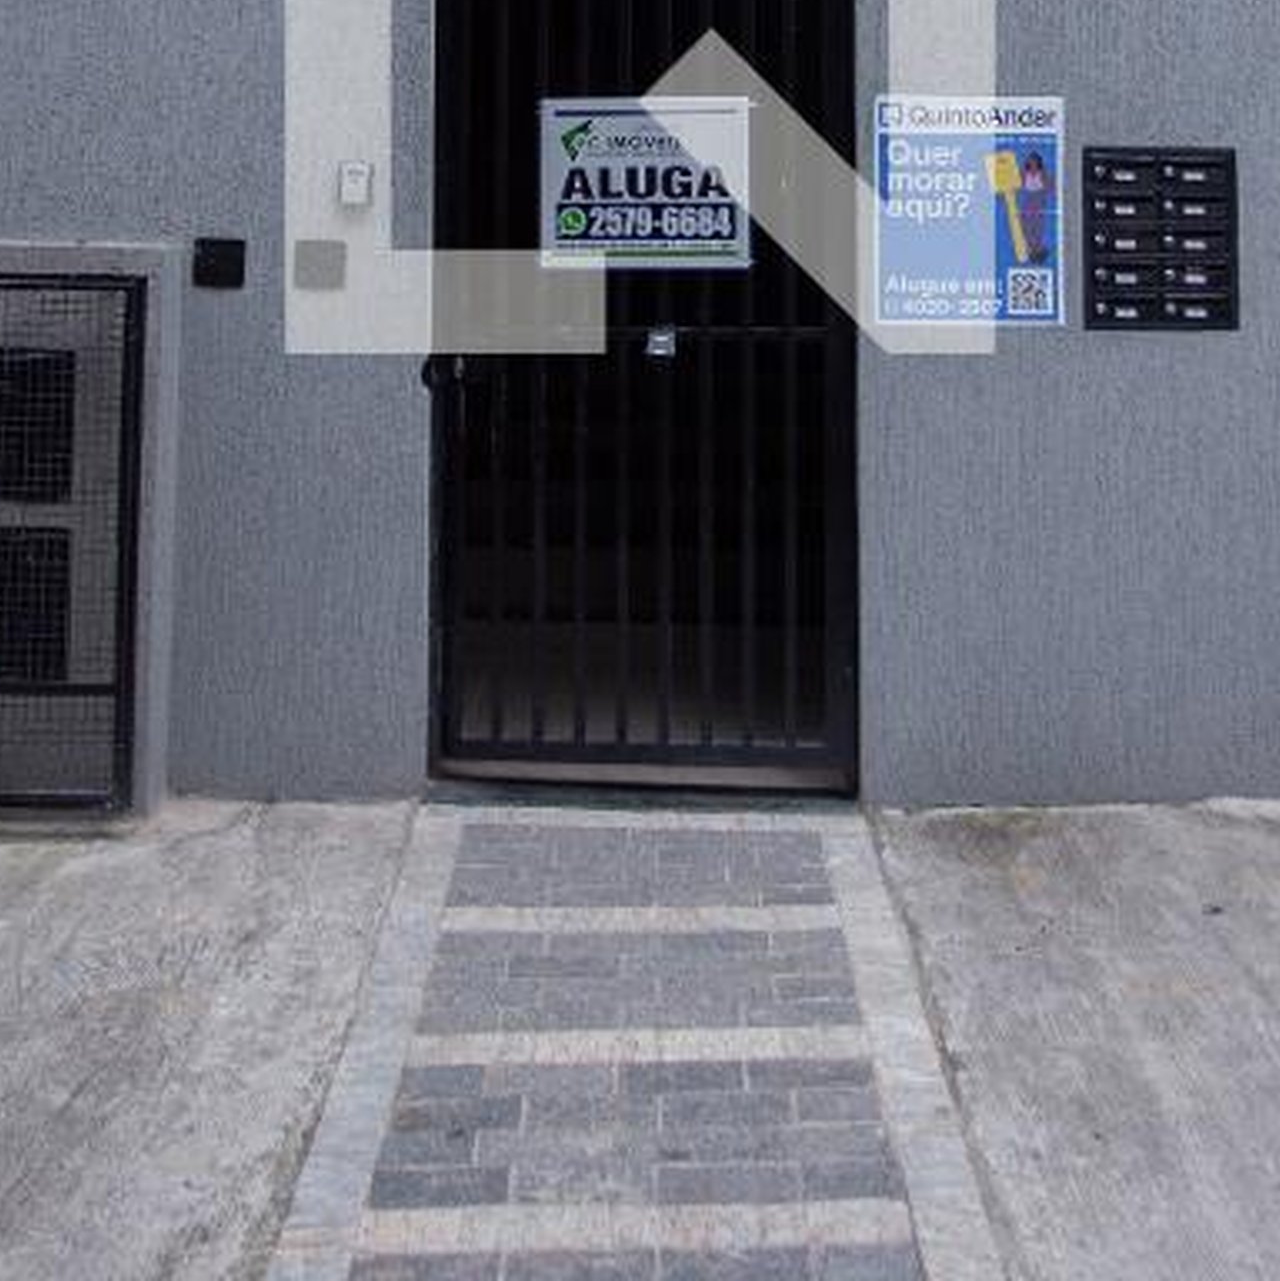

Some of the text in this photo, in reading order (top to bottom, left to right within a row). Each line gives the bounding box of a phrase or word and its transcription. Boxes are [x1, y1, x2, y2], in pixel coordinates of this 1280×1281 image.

[888, 138, 963, 166] Quer
[561, 166, 731, 200] ALUGA
[888, 172, 977, 192] morar
[886, 192, 971, 225] aqui?
